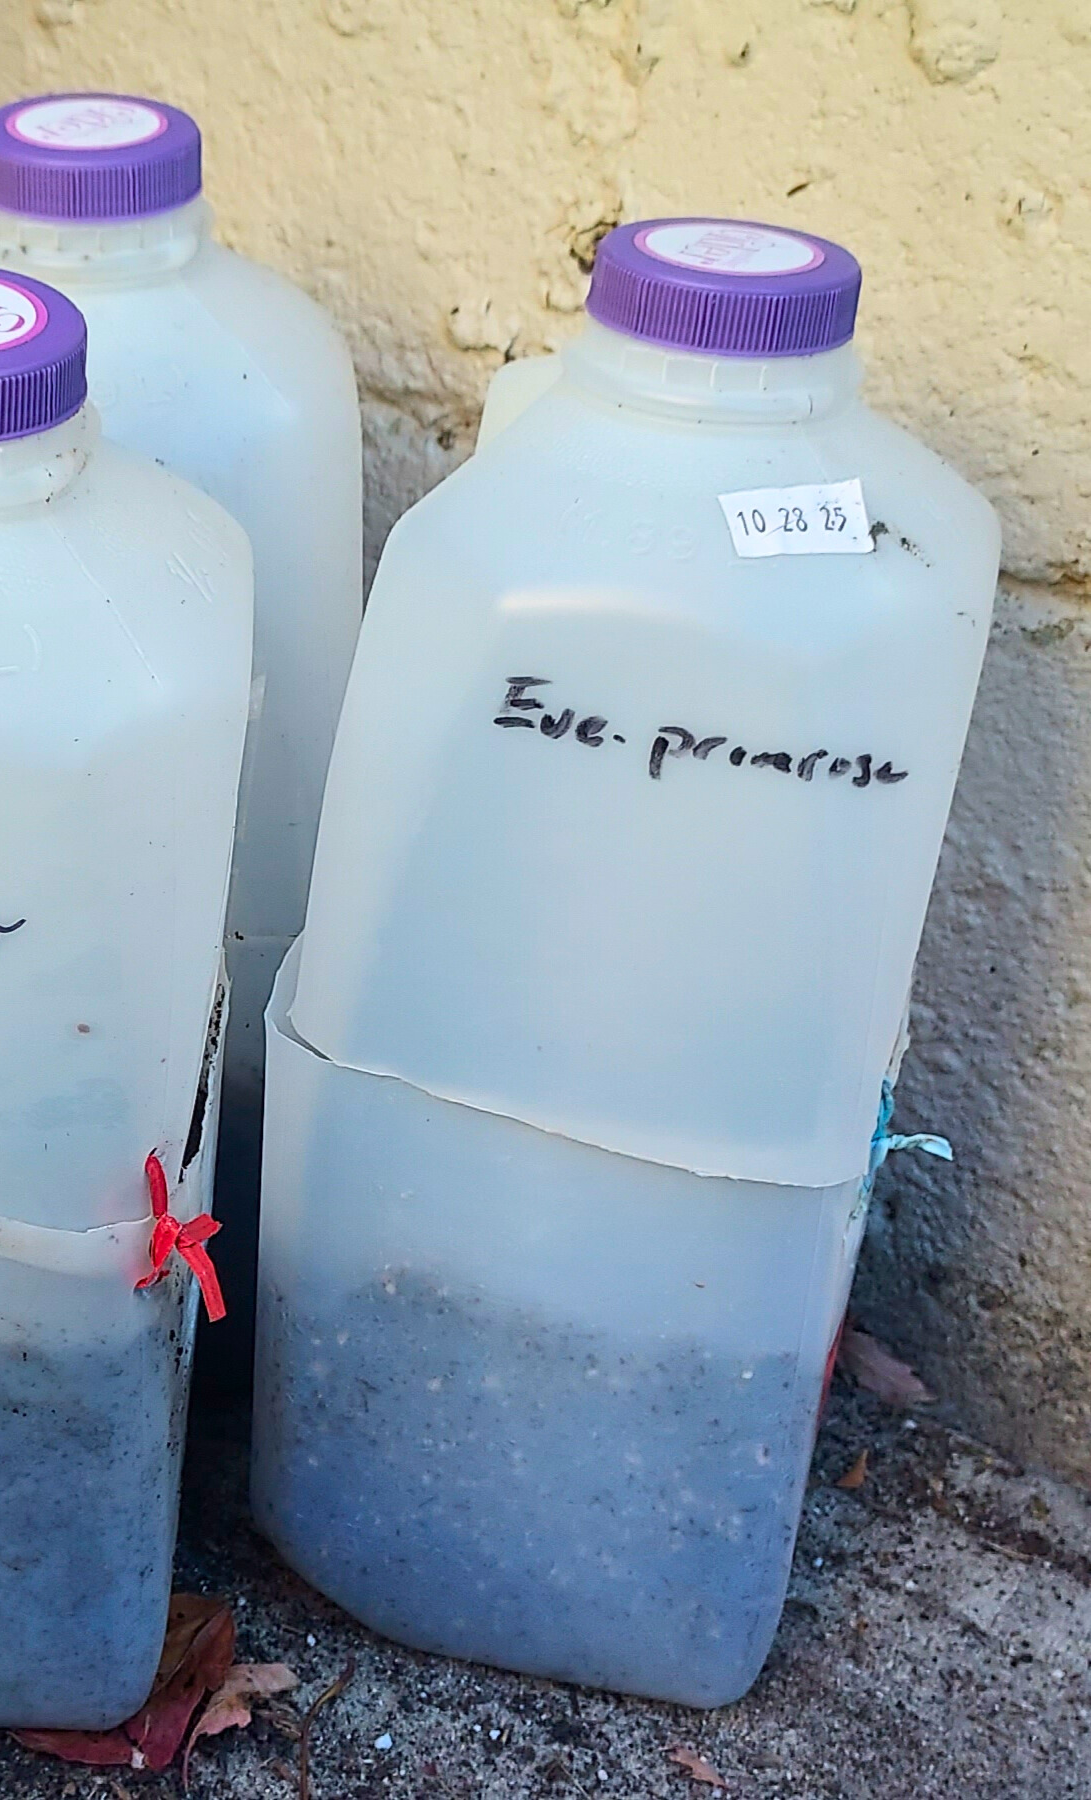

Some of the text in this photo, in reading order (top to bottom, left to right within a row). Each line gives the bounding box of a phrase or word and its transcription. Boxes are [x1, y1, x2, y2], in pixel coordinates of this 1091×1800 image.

[736, 505, 848, 537] 10 28 25
